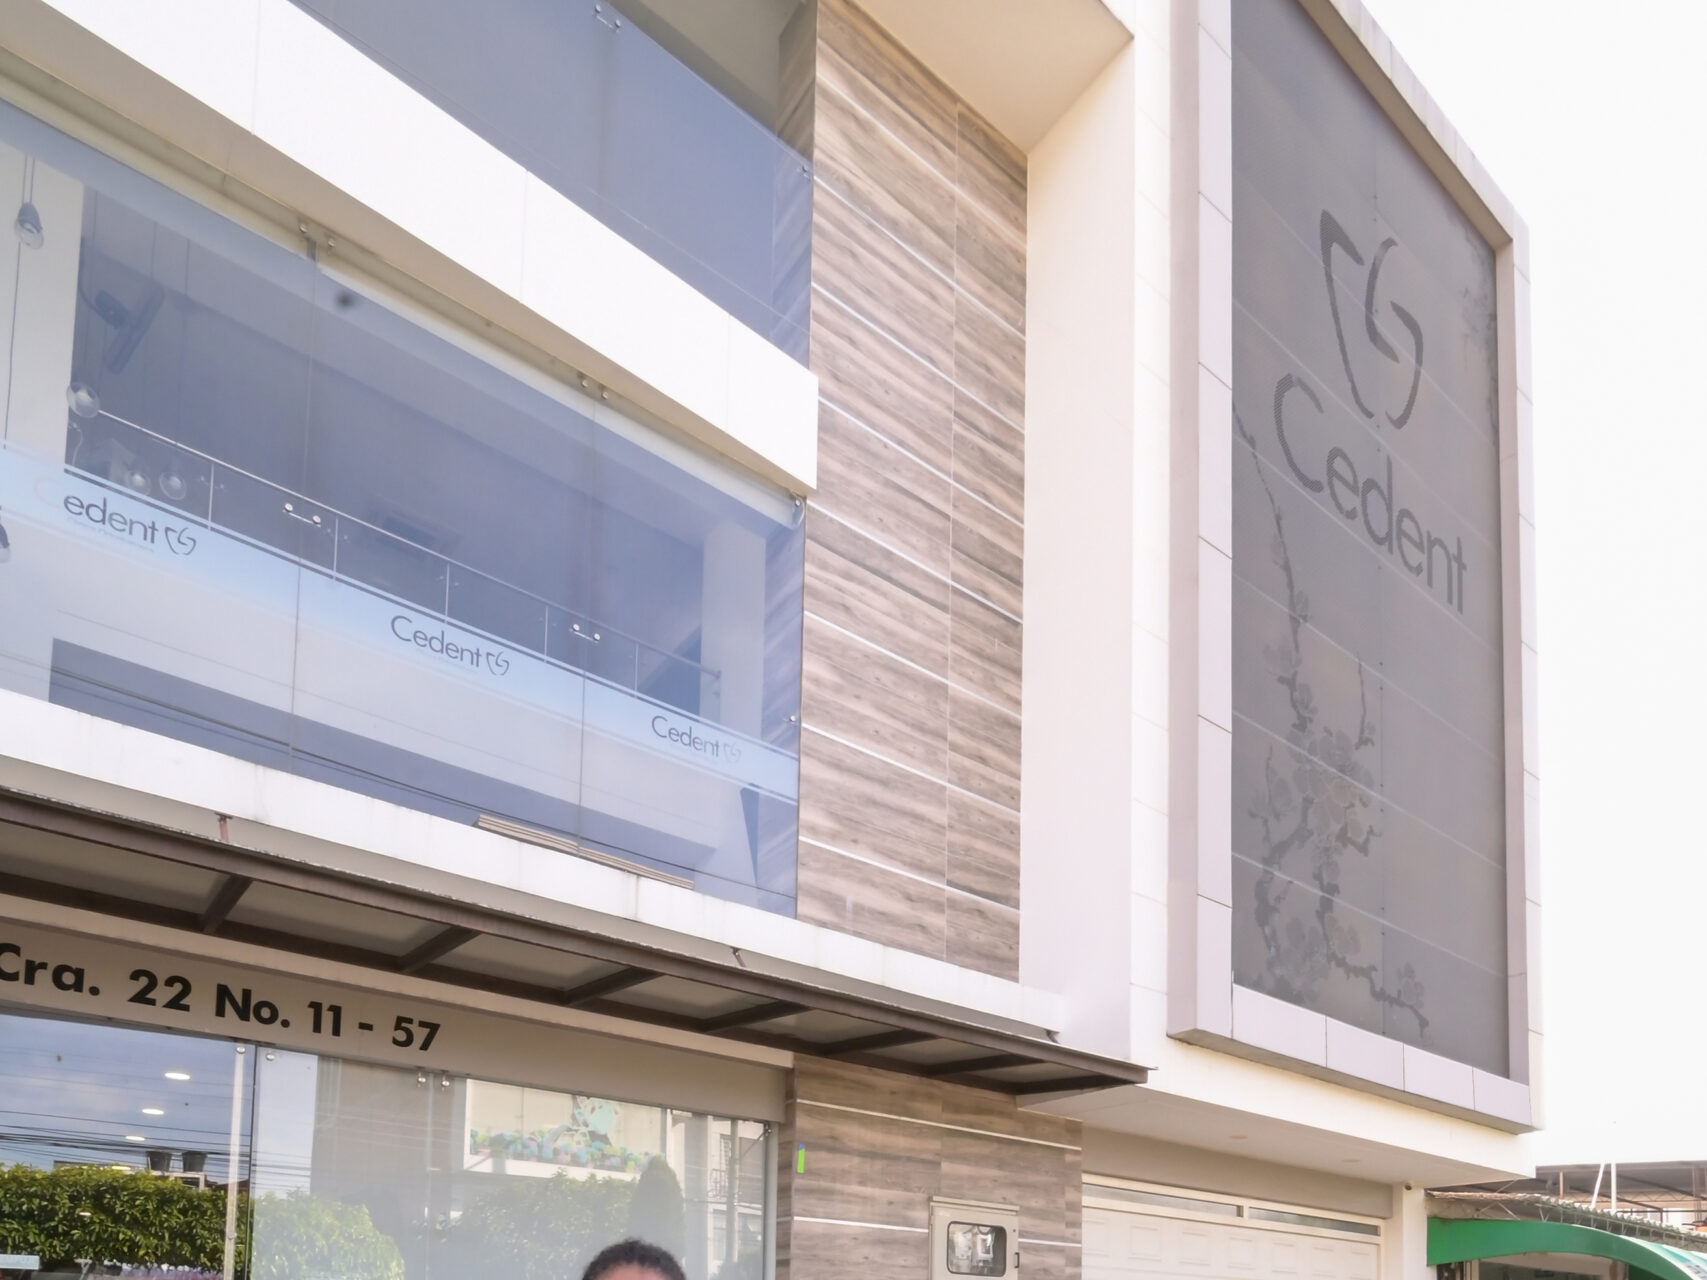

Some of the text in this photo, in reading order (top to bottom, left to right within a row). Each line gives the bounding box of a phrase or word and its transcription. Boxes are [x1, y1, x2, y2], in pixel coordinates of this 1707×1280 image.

[1273, 372, 1467, 615] Cedent
[390, 615, 482, 668] Cedent
[651, 715, 720, 758] Cedent
[0, 942, 442, 1052] Cra. 22 No. 11 - 57
